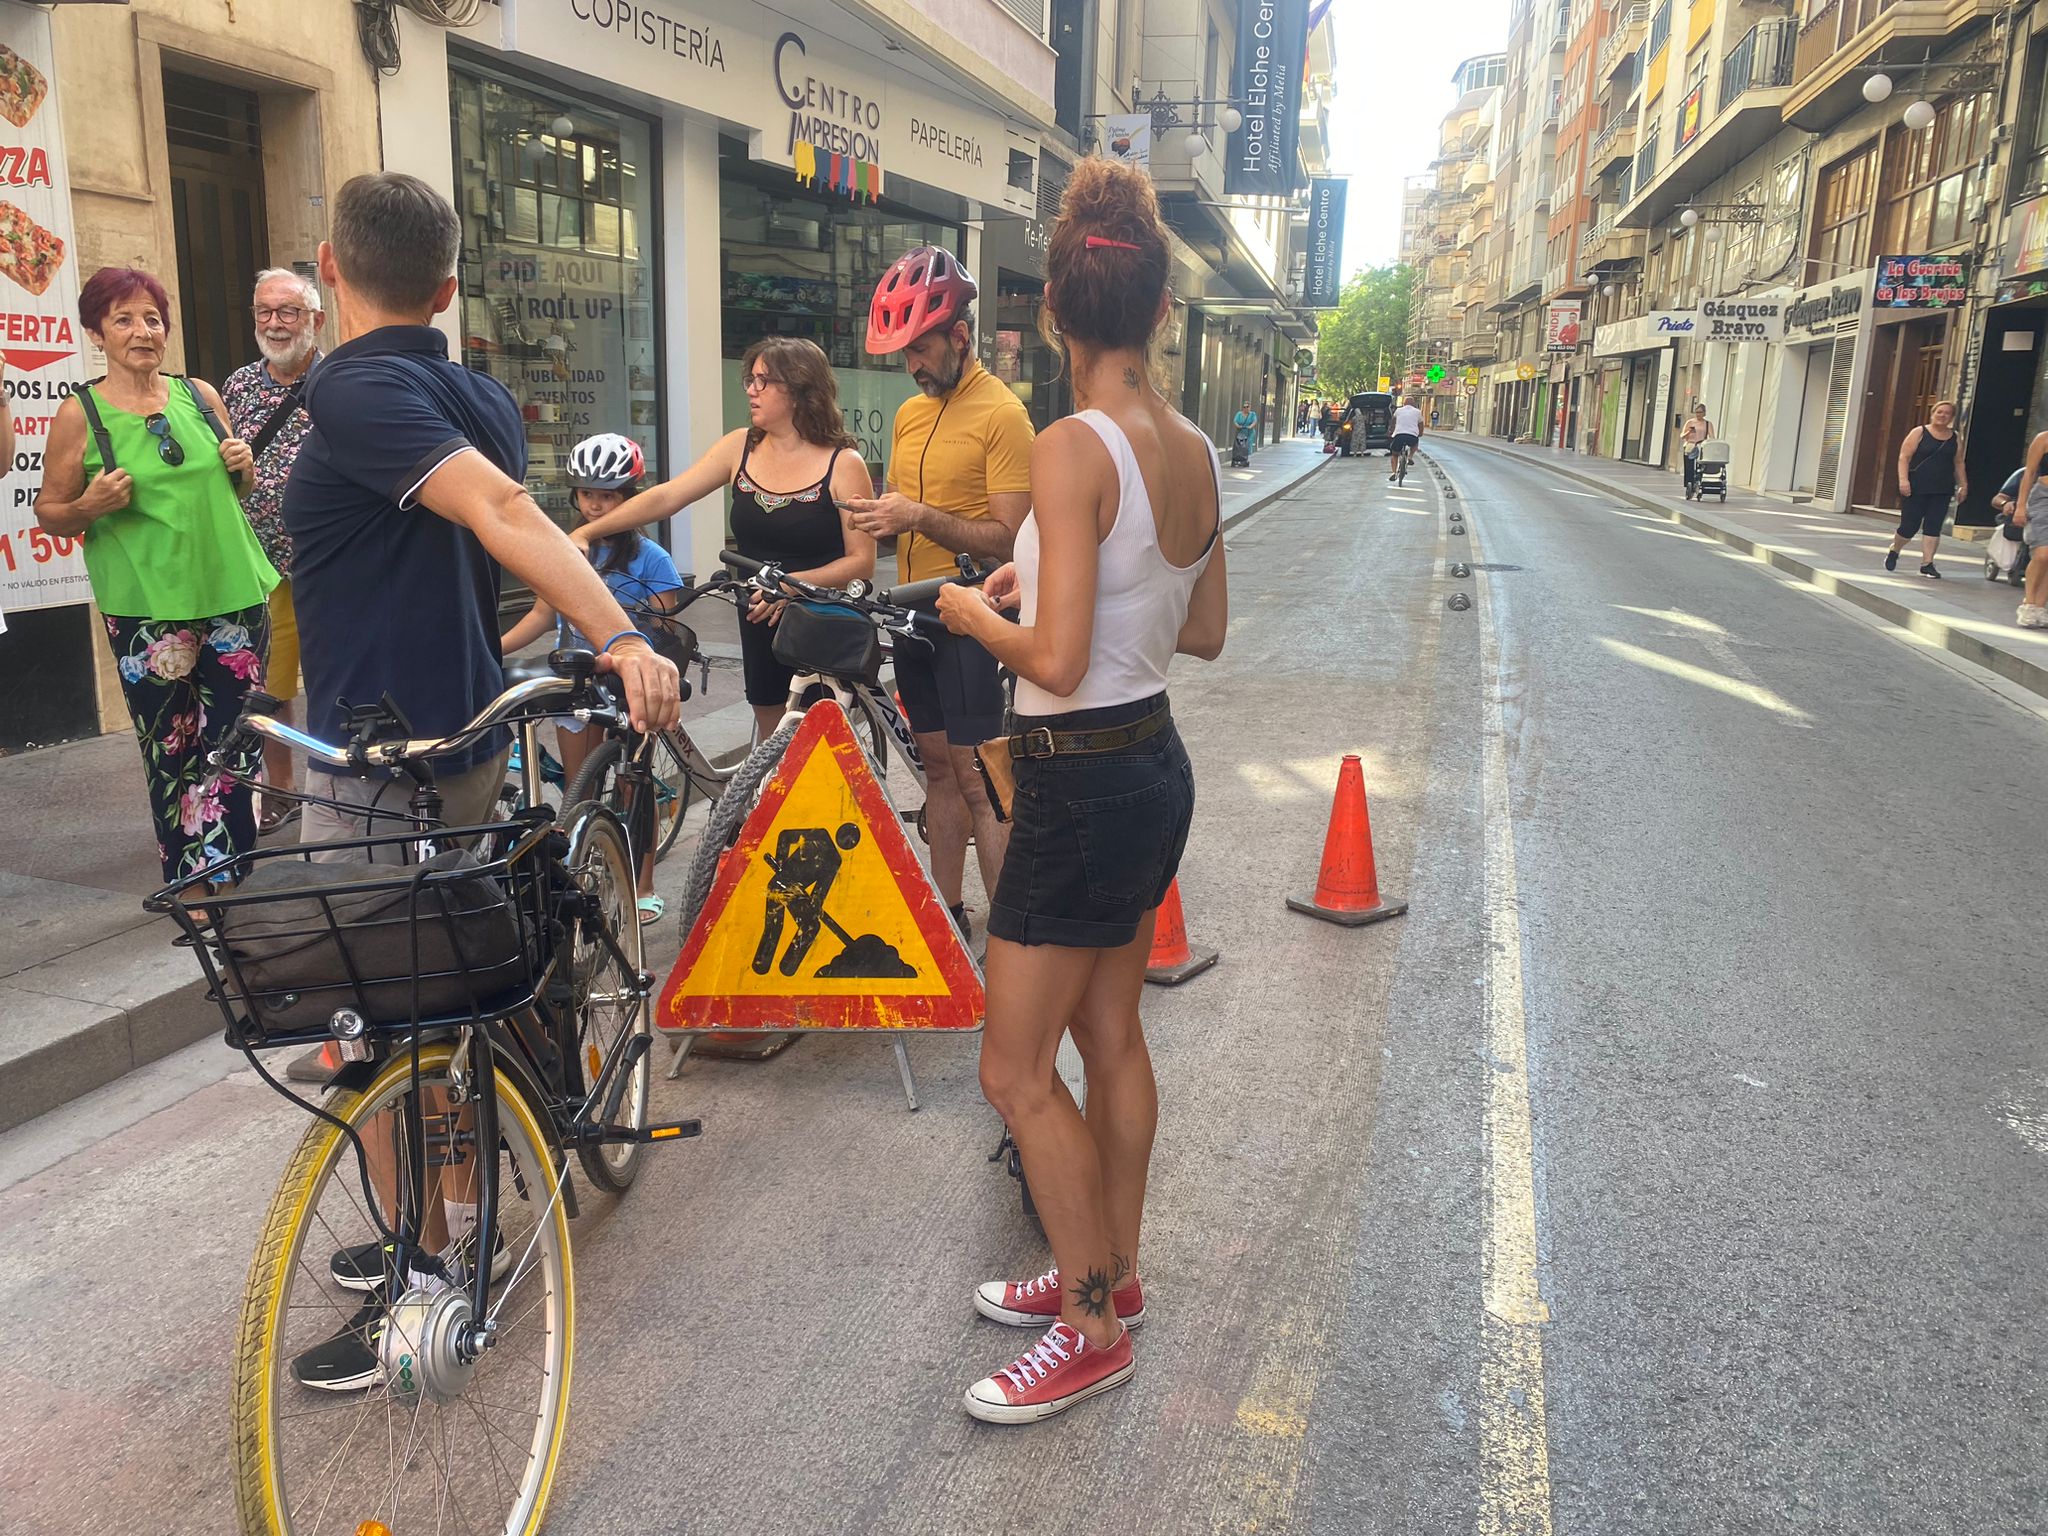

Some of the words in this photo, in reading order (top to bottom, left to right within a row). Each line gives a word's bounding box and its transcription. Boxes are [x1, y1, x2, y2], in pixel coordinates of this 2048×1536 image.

[571, 0, 725, 73] COPISTERÍA
[773, 31, 880, 130] CENTRO
[1248, 46, 1270, 106] Elche
[1273, 65, 1286, 99] Meliá
[1273, 102, 1286, 114] by
[787, 111, 880, 164] IMPRESION
[910, 117, 983, 168] PAPELERÍA
[1242, 115, 1265, 172] Hotel
[1267, 118, 1281, 174] Affiliated
[1317, 189, 1330, 228] Centro
[1024, 219, 1052, 252] Re-Re
[1314, 231, 1327, 262] Elche
[500, 261, 548, 283] PIDE
[554, 261, 604, 285] AQUI
[1312, 266, 1324, 295] Hotel
[1887, 261, 1904, 277] La
[1908, 259, 1962, 277] Guarida
[586, 298, 613, 320] UP
[1703, 301, 1778, 320] Gázquez
[1877, 287, 1892, 300] de
[1897, 286, 1917, 300] las
[1921, 286, 1965, 305] Brujas
[1549, 312, 1559, 344] VENDE
[1658, 317, 1694, 331] Prieto
[1711, 320, 1765, 335] Bravo
[523, 369, 605, 383] PUBLIDAD
[8, 581, 19, 590] NO
[21, 577, 48, 589] VÁLIDO
[50, 578, 59, 586] EN
